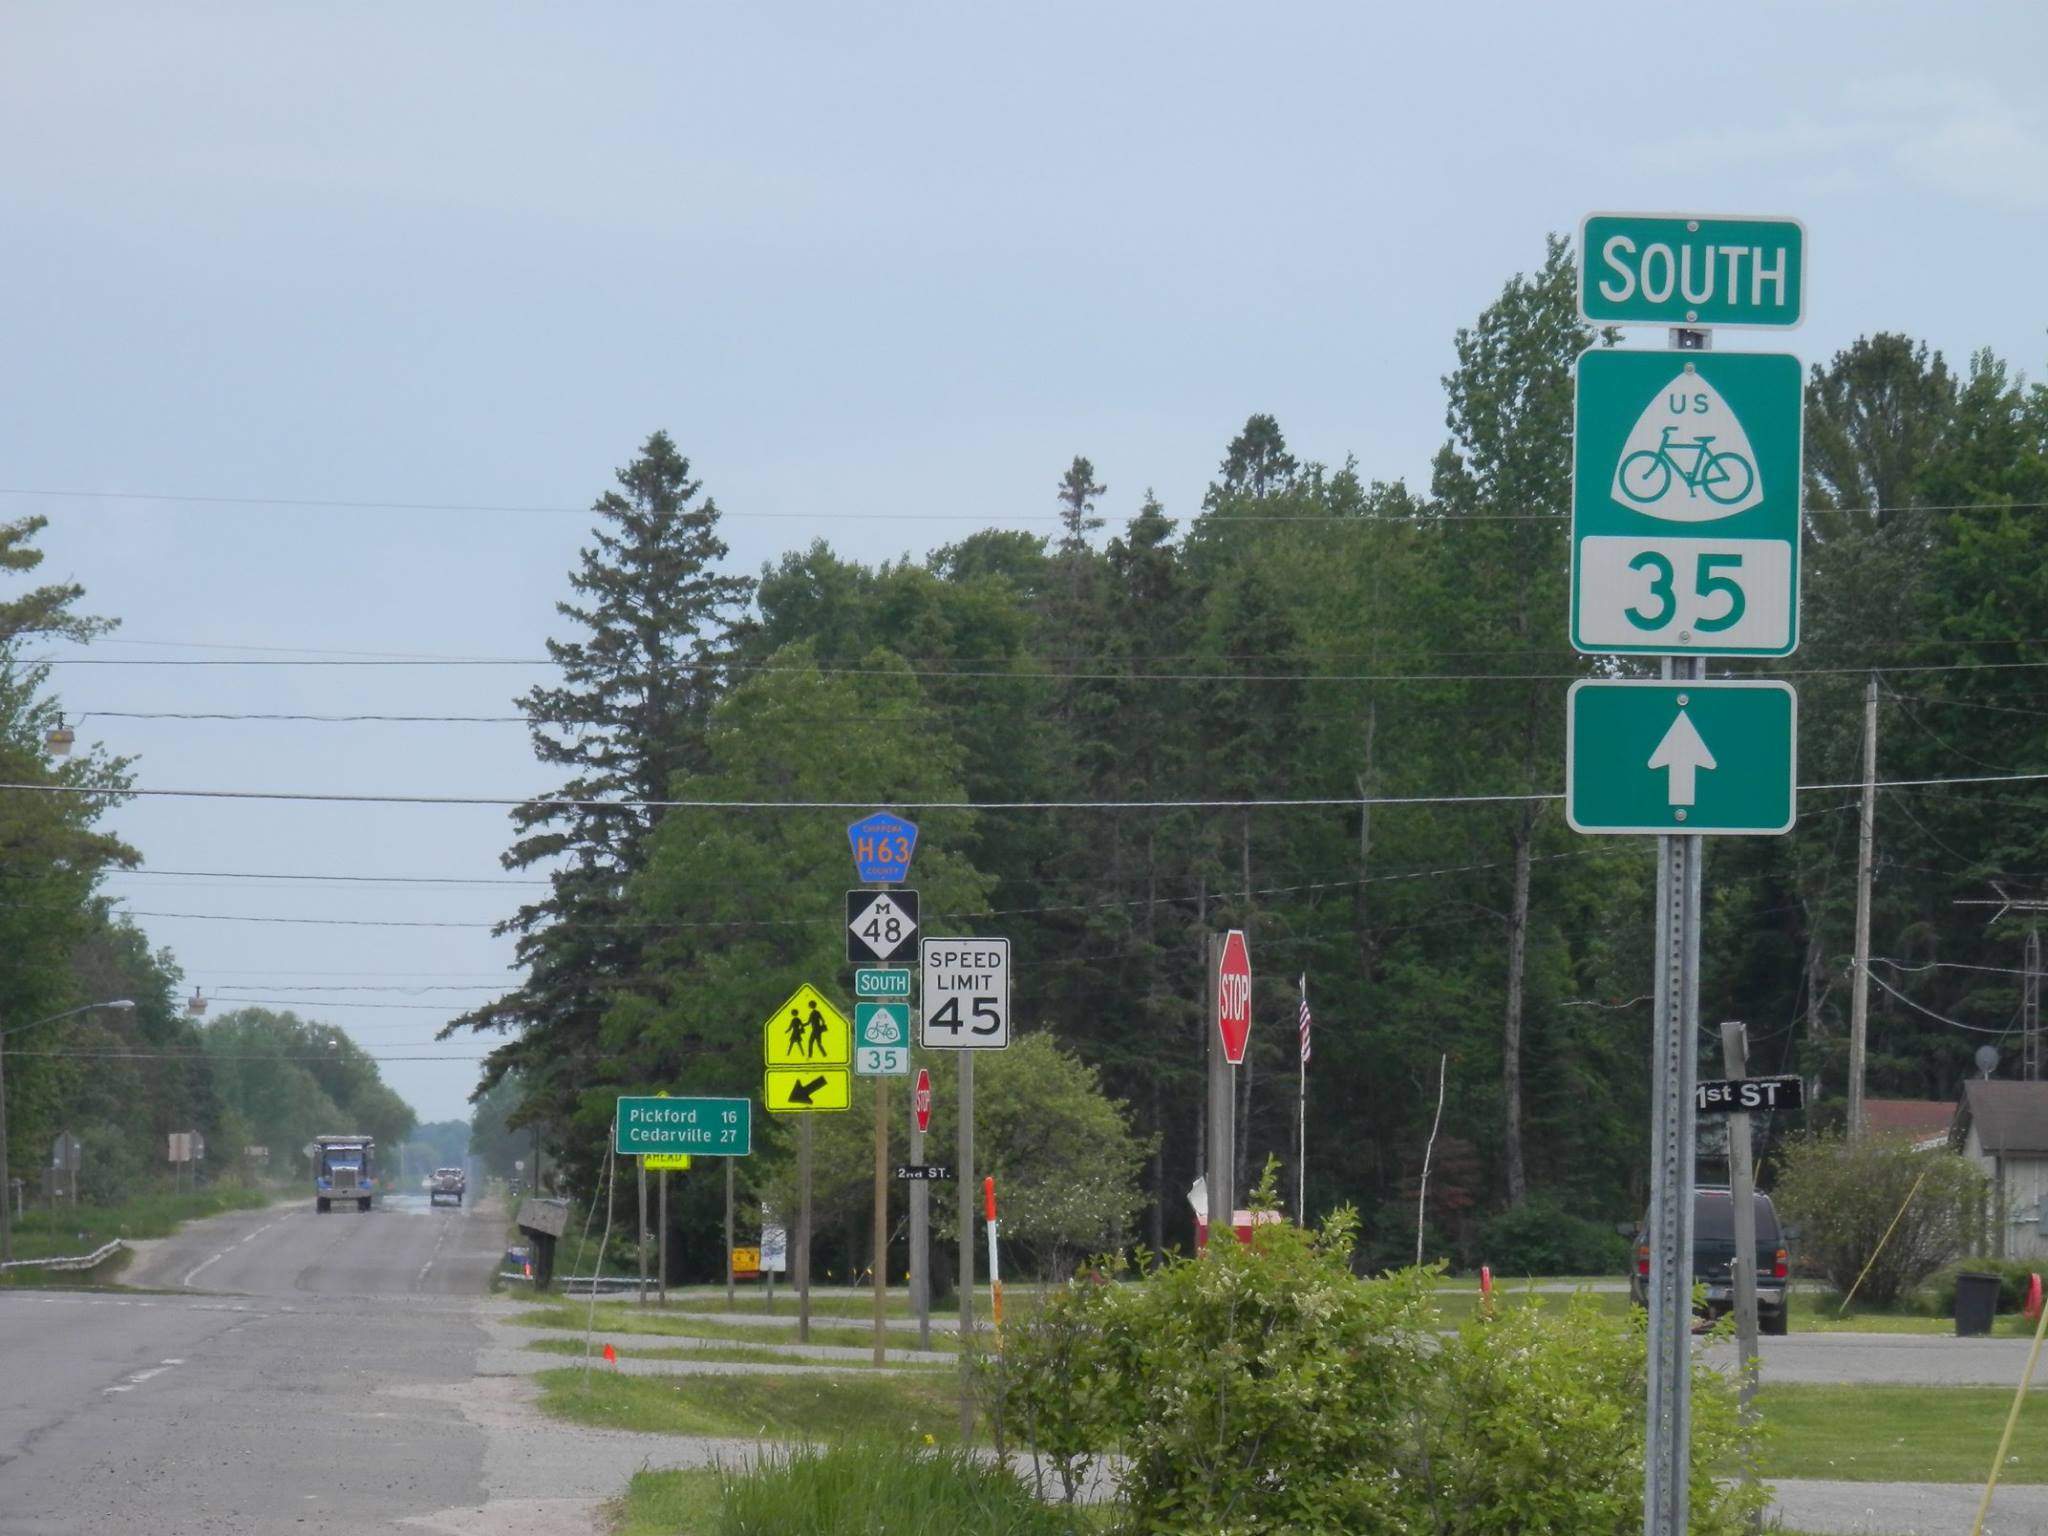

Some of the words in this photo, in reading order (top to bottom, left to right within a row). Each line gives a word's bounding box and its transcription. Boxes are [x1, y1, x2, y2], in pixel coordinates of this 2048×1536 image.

[1599, 236, 1786, 307] SOUTH
[1669, 393, 1709, 415] US
[1624, 550, 1746, 633] 35
[857, 836, 909, 864] H63
[875, 904, 891, 914] M
[863, 918, 902, 944] 48
[930, 952, 1001, 968] SPEED
[860, 975, 906, 992] SOUTH
[937, 975, 993, 991] LIMIT
[1221, 973, 1249, 1021] STOP
[929, 997, 1001, 1036] 45
[868, 1051, 897, 1070] 35
[916, 1090, 930, 1112] STOP
[1695, 1085, 1732, 1109] 1st
[1740, 1082, 1781, 1106] ST
[630, 1109, 696, 1123] Pickford
[721, 1111, 737, 1124] 16
[630, 1128, 712, 1142] Cedarville
[720, 1130, 737, 1143] 27
[898, 1168, 923, 1178] 2nd
[928, 1167, 951, 1178] ST.
